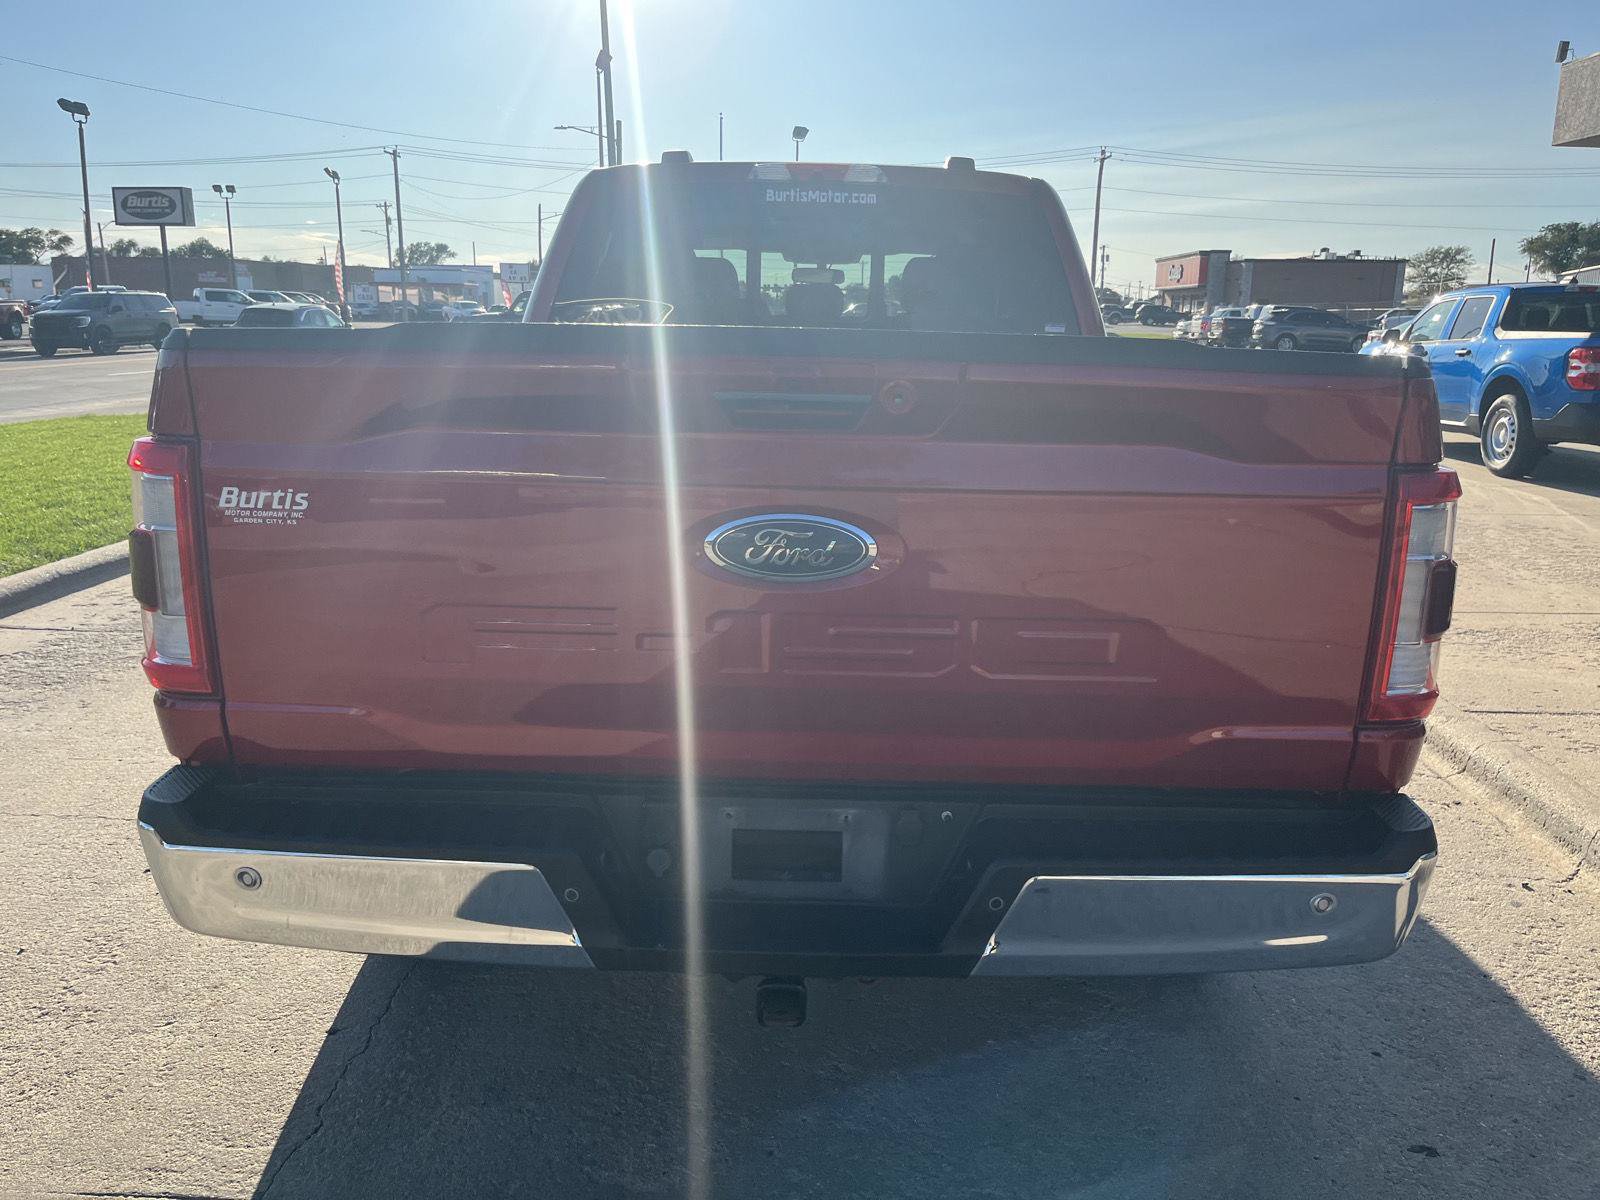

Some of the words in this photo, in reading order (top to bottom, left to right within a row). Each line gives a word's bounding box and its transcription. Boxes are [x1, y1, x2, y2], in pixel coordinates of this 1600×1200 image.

[127, 195, 170, 207] Burtis
[766, 188, 877, 204] BurtisMotor.com
[219, 486, 309, 510] Burtis
[252, 510, 288, 518] COMPANY,
[745, 528, 837, 566] Ford
